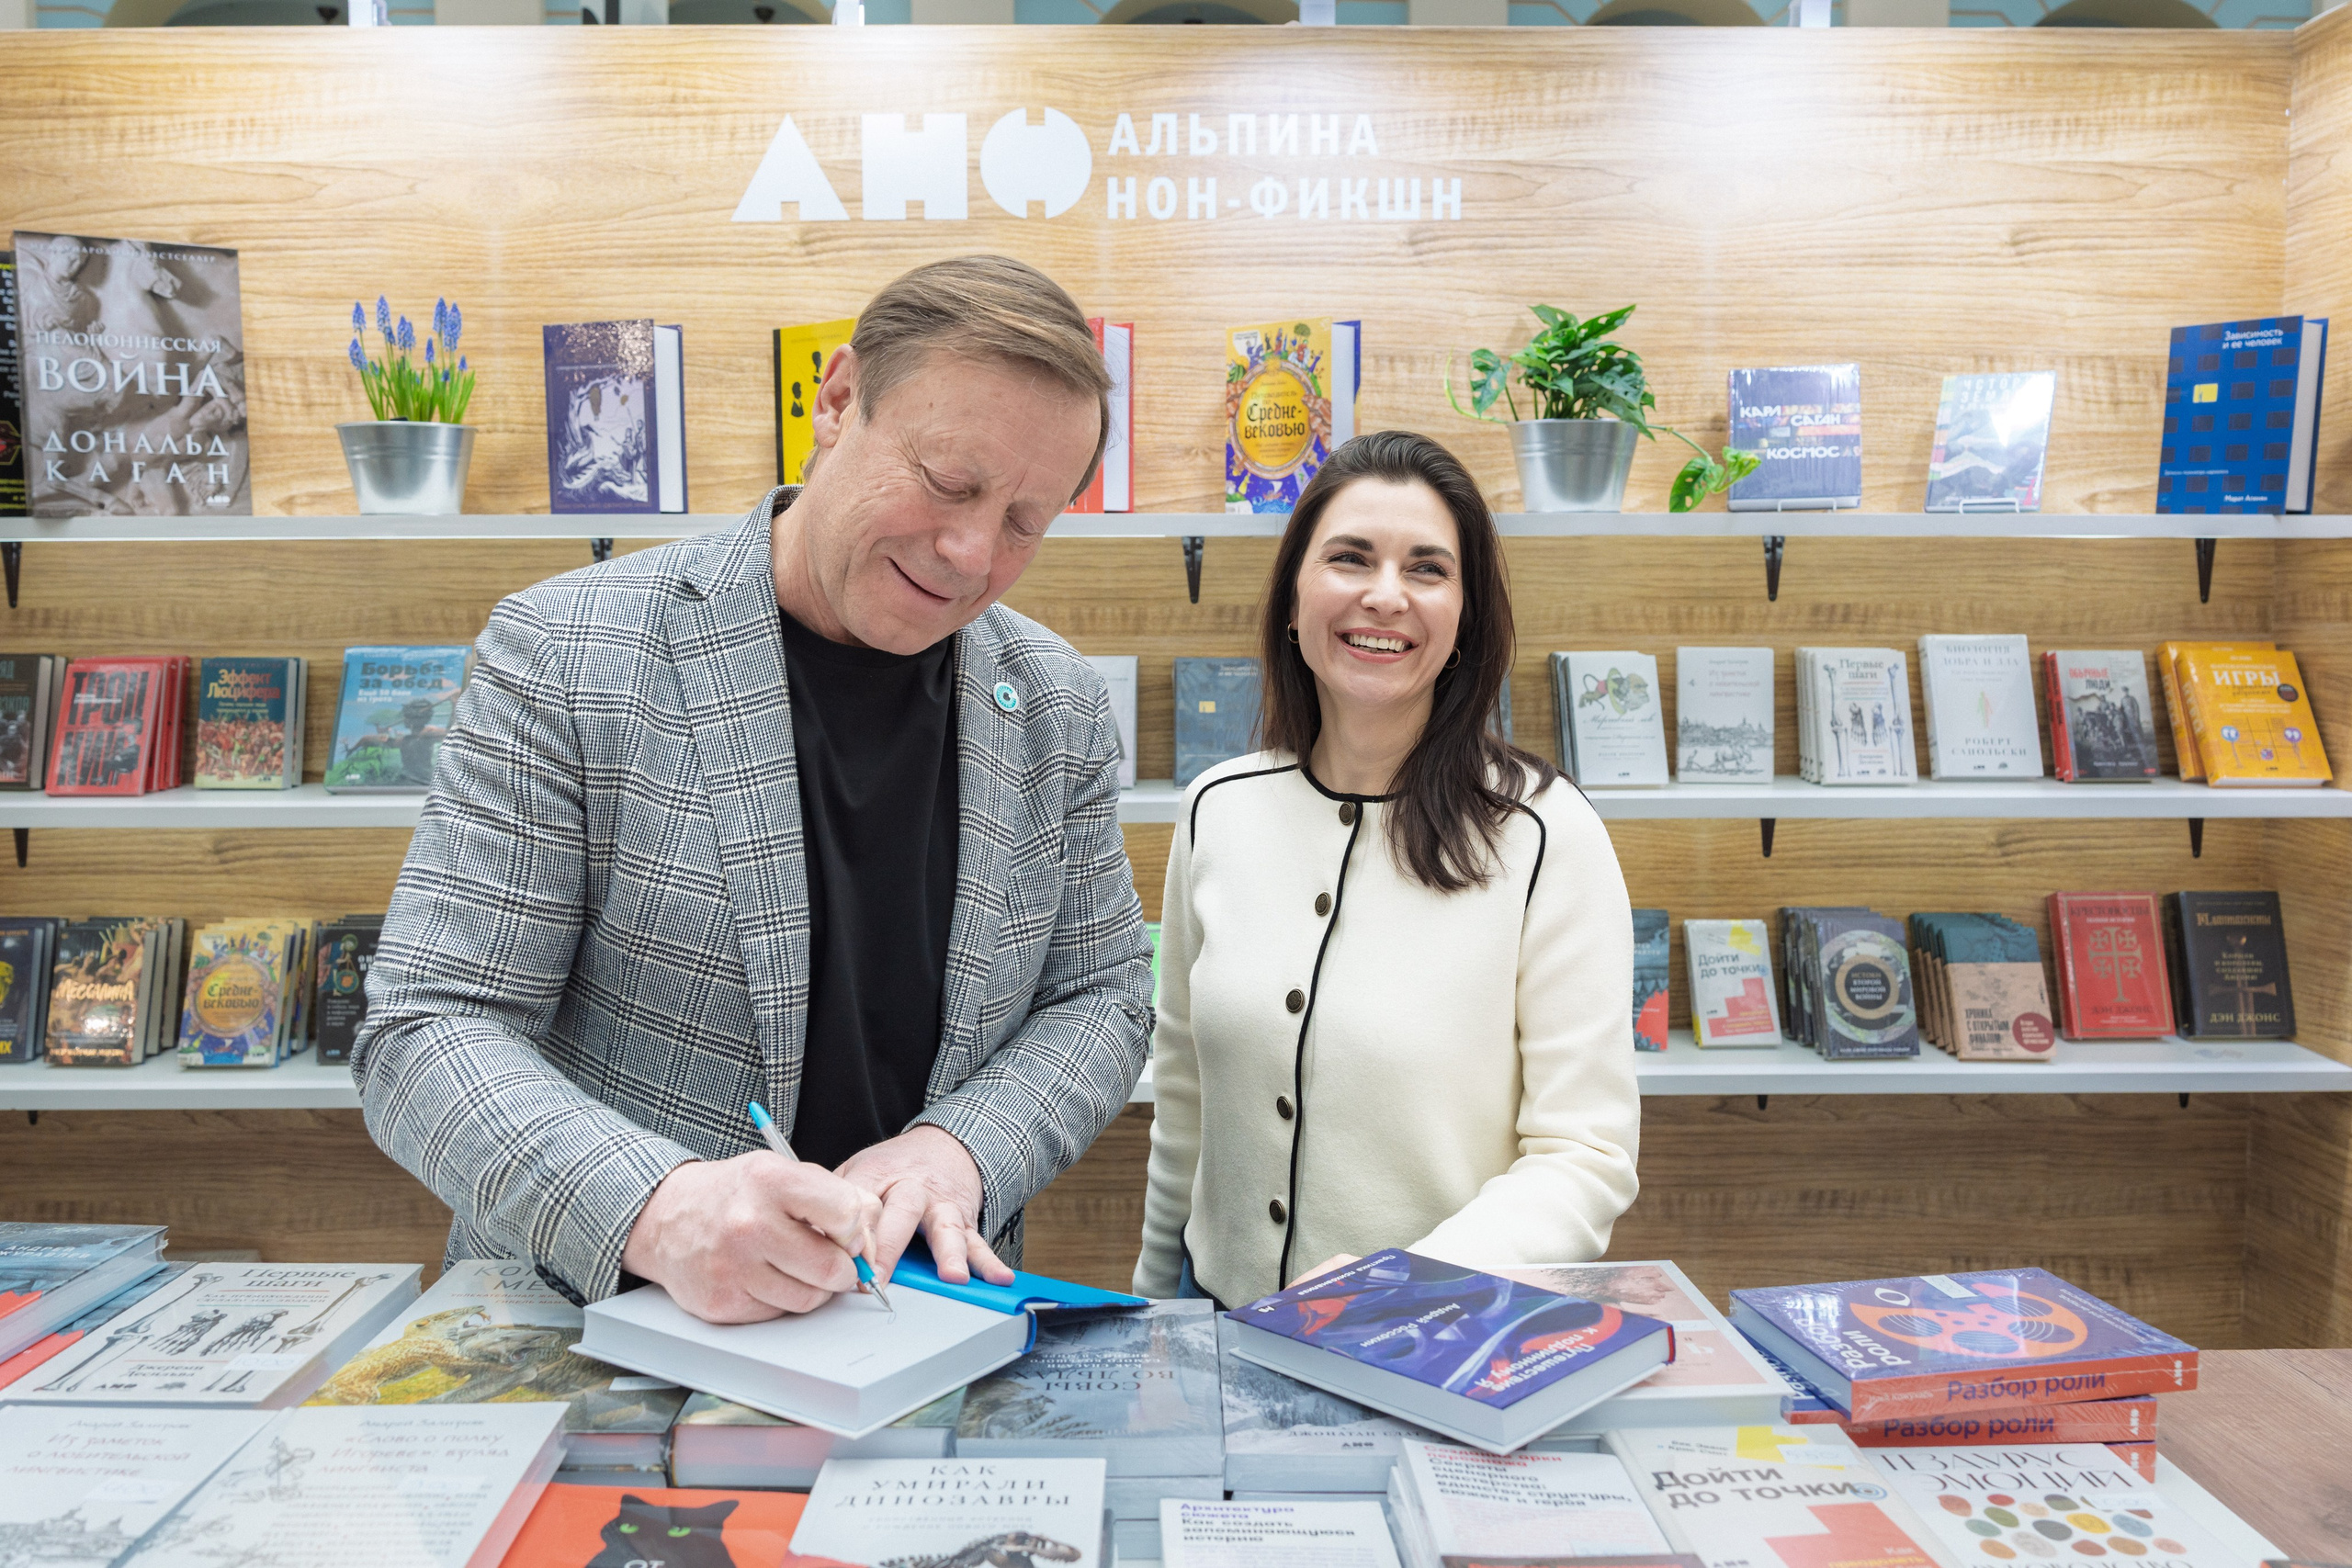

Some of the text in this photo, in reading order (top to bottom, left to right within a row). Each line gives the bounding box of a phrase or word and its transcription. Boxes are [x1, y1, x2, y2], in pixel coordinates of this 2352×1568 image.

[1108, 112, 1379, 157] АЛЬПИНА
[731, 107, 1093, 221] АНО
[1107, 175, 1464, 221] НОН-ФИКШН
[35, 330, 222, 354] ПЕЛОПОННЕССКАЯ
[2224, 328, 2284, 341] Зависимость
[2245, 337, 2283, 348] человек
[39, 350, 231, 399] ВОЙНА
[1247, 402, 1302, 424] Средне-
[1740, 405, 1781, 418] КАРЛ
[1790, 413, 1841, 427] САГАН
[1245, 422, 1306, 439] вековью
[42, 429, 230, 457] ДОНАЛЬД
[1766, 446, 1840, 460] КОСМОС
[47, 460, 230, 485] КАГАН
[1945, 645, 2011, 654] БИОЛОГИЯ
[361, 661, 446, 678] Борьба
[1839, 659, 1884, 671] Первые
[219, 668, 272, 688] Эффект
[358, 676, 444, 690] за обед
[1849, 671, 1878, 680] шаги
[2211, 670, 2282, 687] ИГРЫ
[207, 682, 281, 702] Люцифера
[1964, 737, 2011, 746] РОБЕРТ
[1951, 748, 2027, 756] САПОЛЬСКИ
[1698, 953, 1740, 966] Дойти
[1701, 963, 1761, 979] до точки
[208, 983, 258, 998] Средне-
[203, 997, 261, 1010] вековью
[2210, 1012, 2281, 1023] ДЭН ДЖОНС
[1356, 1253, 1397, 1274] Практика
[238, 1269, 356, 1280] Первые
[1296, 1269, 1357, 1297] психоанализа
[1414, 1302, 1462, 1325] Андрей
[1360, 1322, 1419, 1348] Россохин
[1490, 1333, 1585, 1380] подлинному
[1131, 1370, 1174, 1380] ВО
[1490, 1342, 1596, 1393] Путешествие
[1045, 1381, 1141, 1392] СОВЫ
[1948, 1374, 2037, 1402] Разбор
[2044, 1371, 2106, 1396] роли
[1883, 1417, 1981, 1439] Разбор
[1988, 1415, 2055, 1438] роли
[1426, 1451, 1528, 1468] персонажа
[1430, 1458, 1508, 1472] Секреты
[930, 1465, 998, 1476] КАК
[1431, 1465, 1539, 1483] сценарного
[872, 1480, 1046, 1491] УМИРАЛИ
[1437, 1480, 1633, 1503] единство структуры,
[834, 1495, 1070, 1507] ДИНОЗАВРЫ
[1440, 1487, 1586, 1507] сюжета и героя
[1181, 1503, 1295, 1514] Архитектура
[1182, 1528, 1355, 1537] запоминающуюся
[1183, 1535, 1264, 1543] историю
